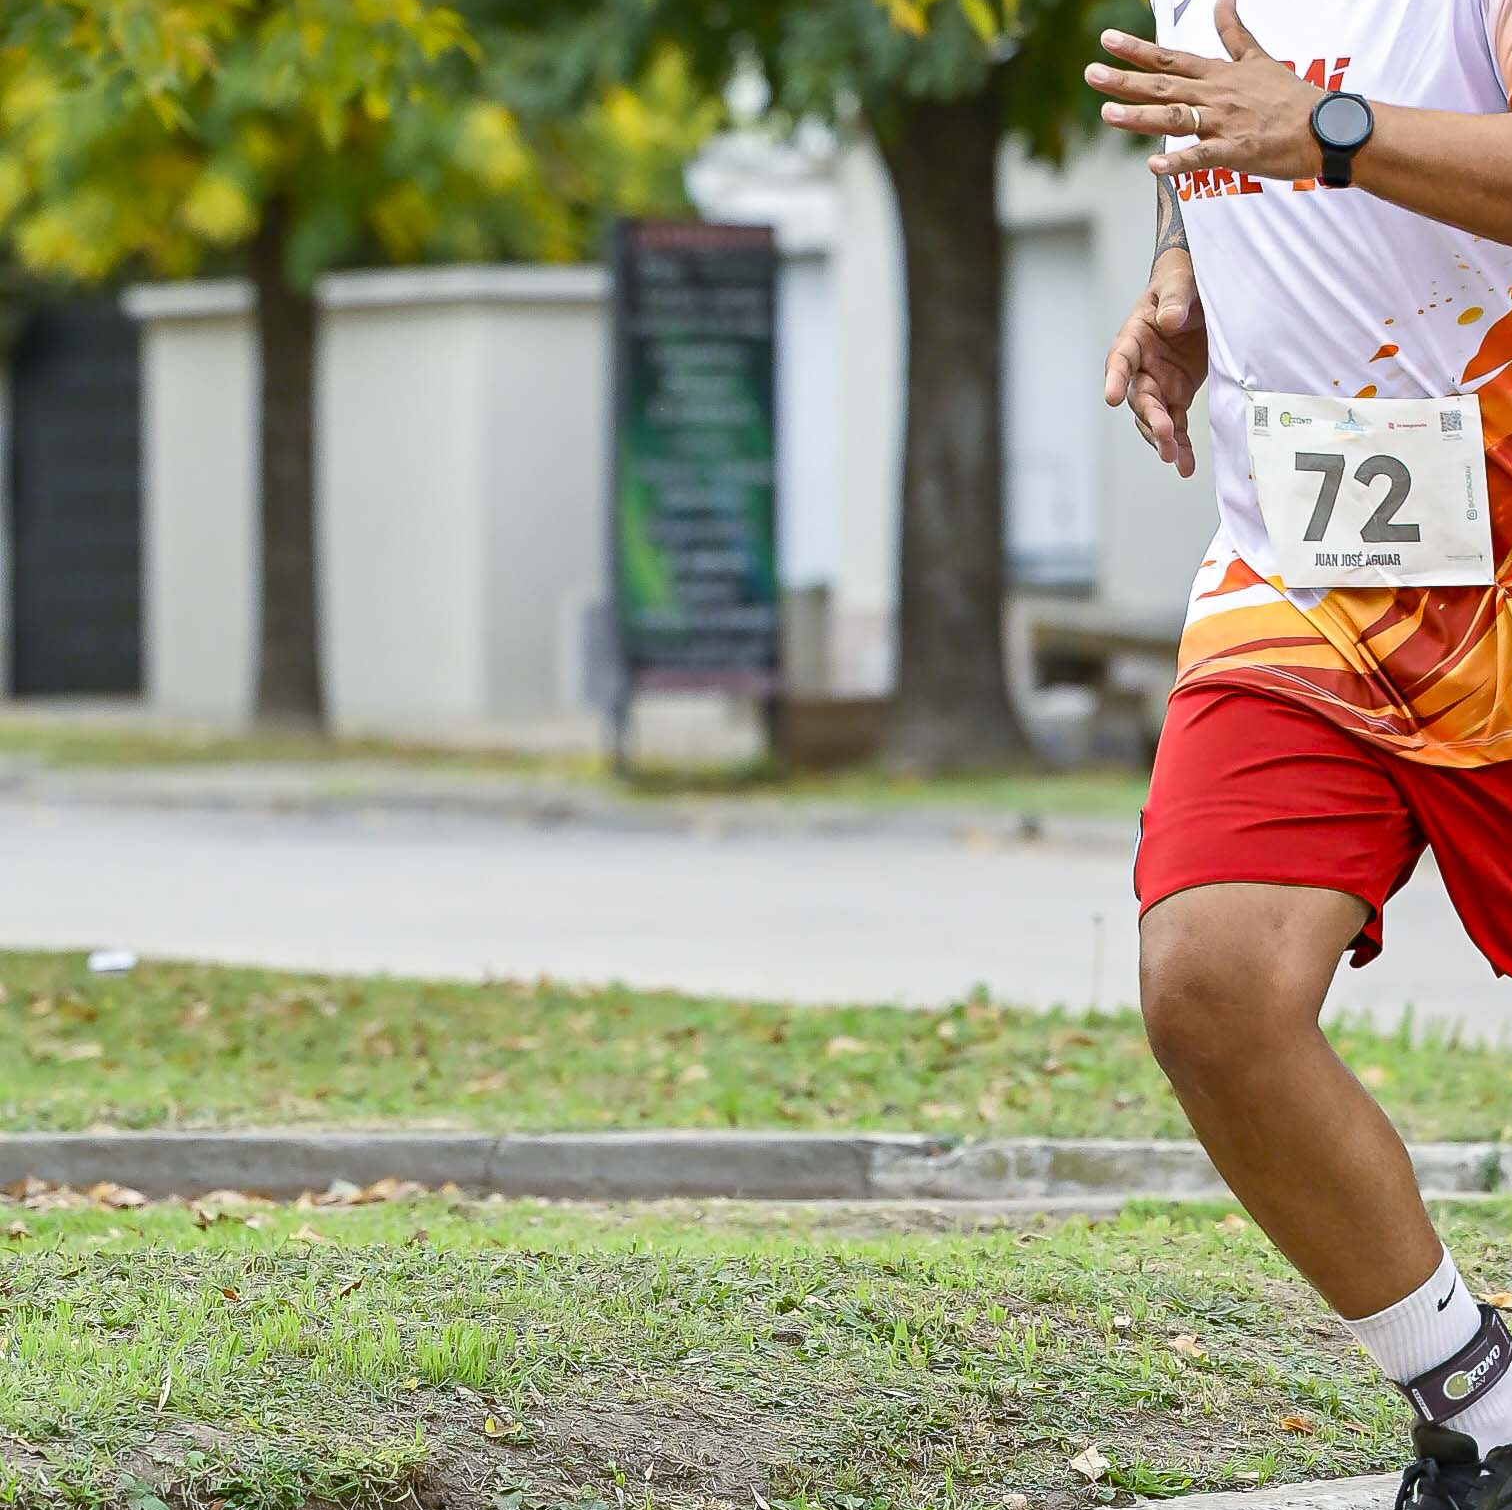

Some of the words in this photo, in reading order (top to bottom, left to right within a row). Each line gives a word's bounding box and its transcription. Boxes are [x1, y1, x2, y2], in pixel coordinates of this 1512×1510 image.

[1294, 451, 1421, 543] 72
[1314, 553, 1338, 567] JUAN
[1340, 551, 1364, 567] JOSÉ
[1365, 553, 1402, 566] AGUIAR
